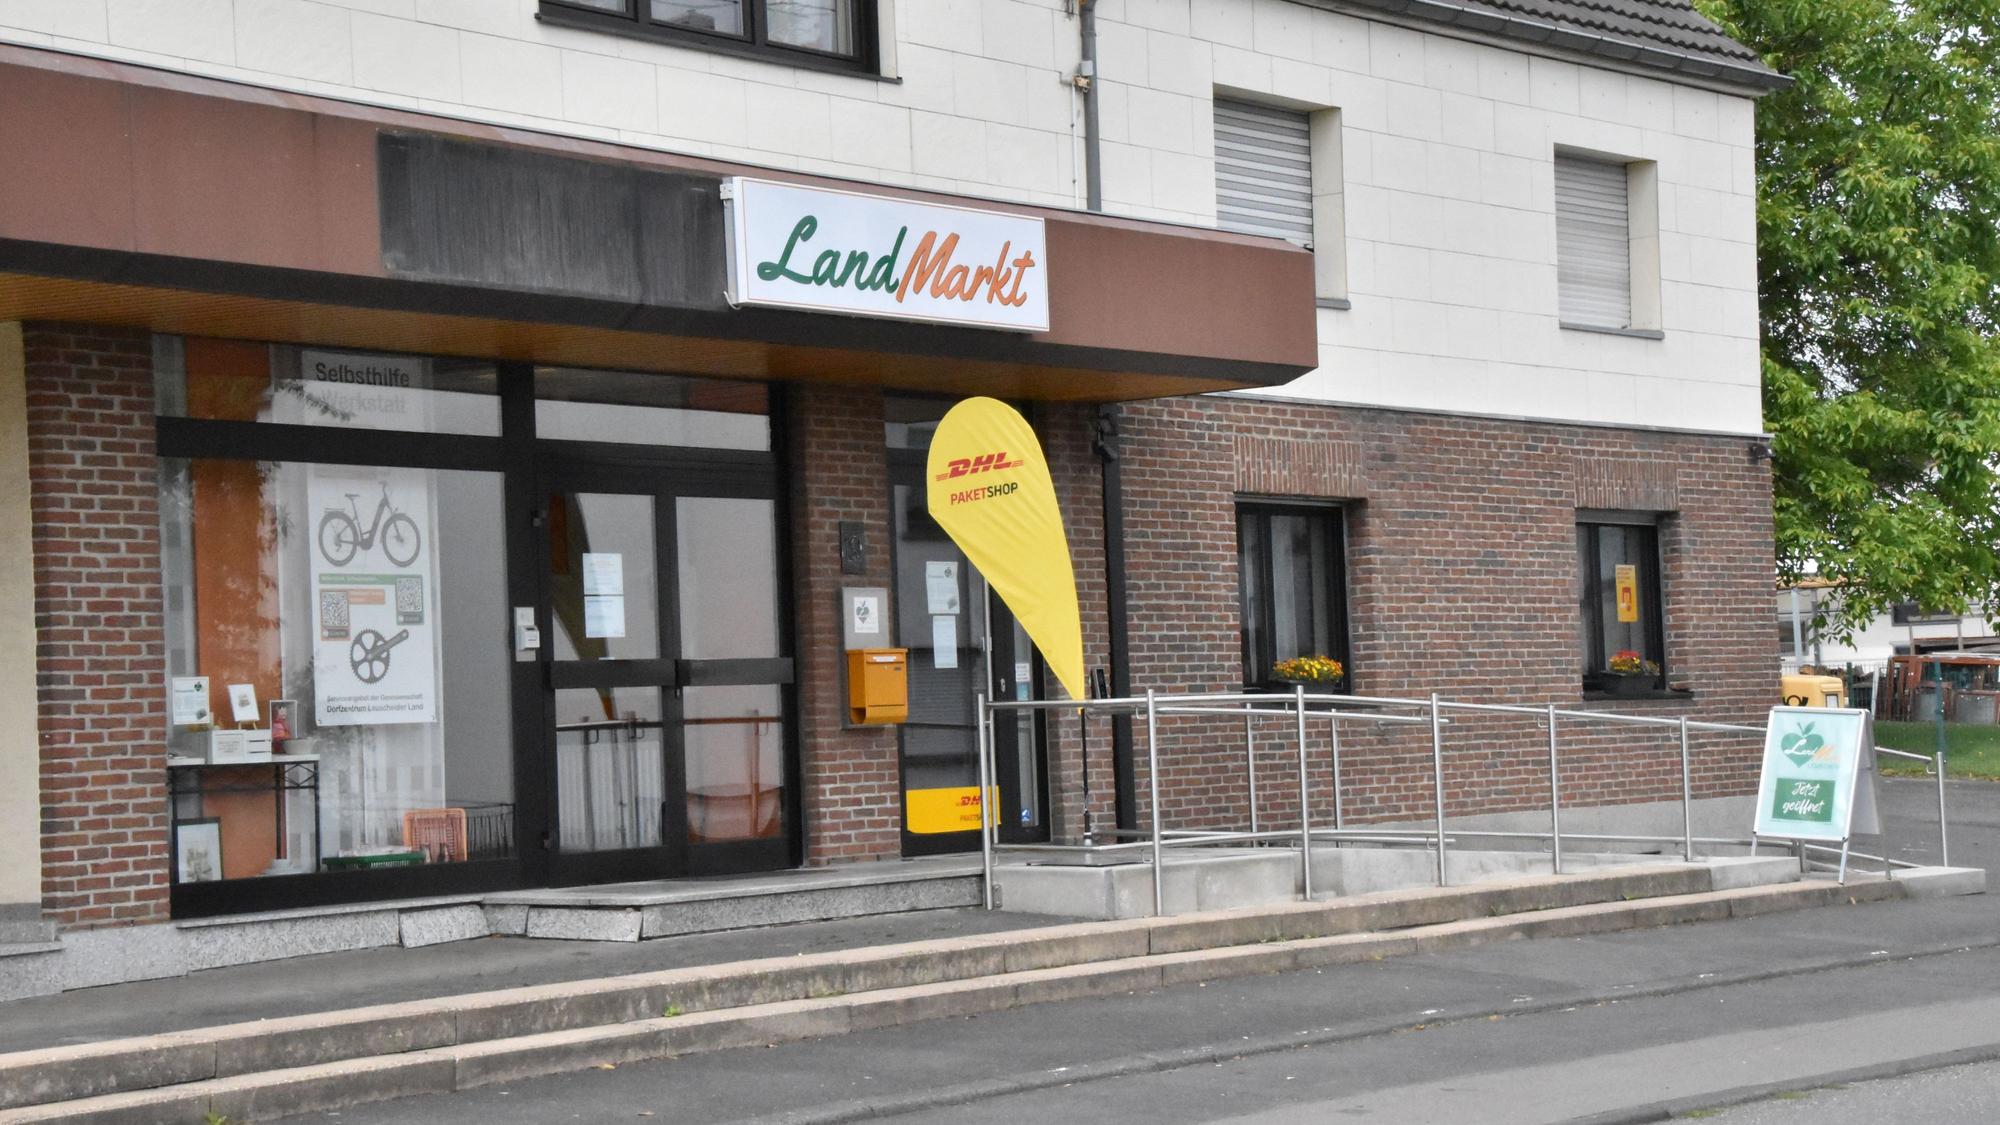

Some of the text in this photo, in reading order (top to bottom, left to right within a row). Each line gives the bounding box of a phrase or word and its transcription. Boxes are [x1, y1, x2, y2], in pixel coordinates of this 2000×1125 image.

[757, 215, 1036, 307] LandMarkt
[315, 361, 410, 388] Selbsthilfe
[947, 452, 1012, 479] DHL
[950, 482, 1018, 505] PAKETSHOP
[326, 704, 367, 713] Dorfzentrum
[407, 703, 424, 711] Land
[1791, 782, 1820, 797] Jetzt
